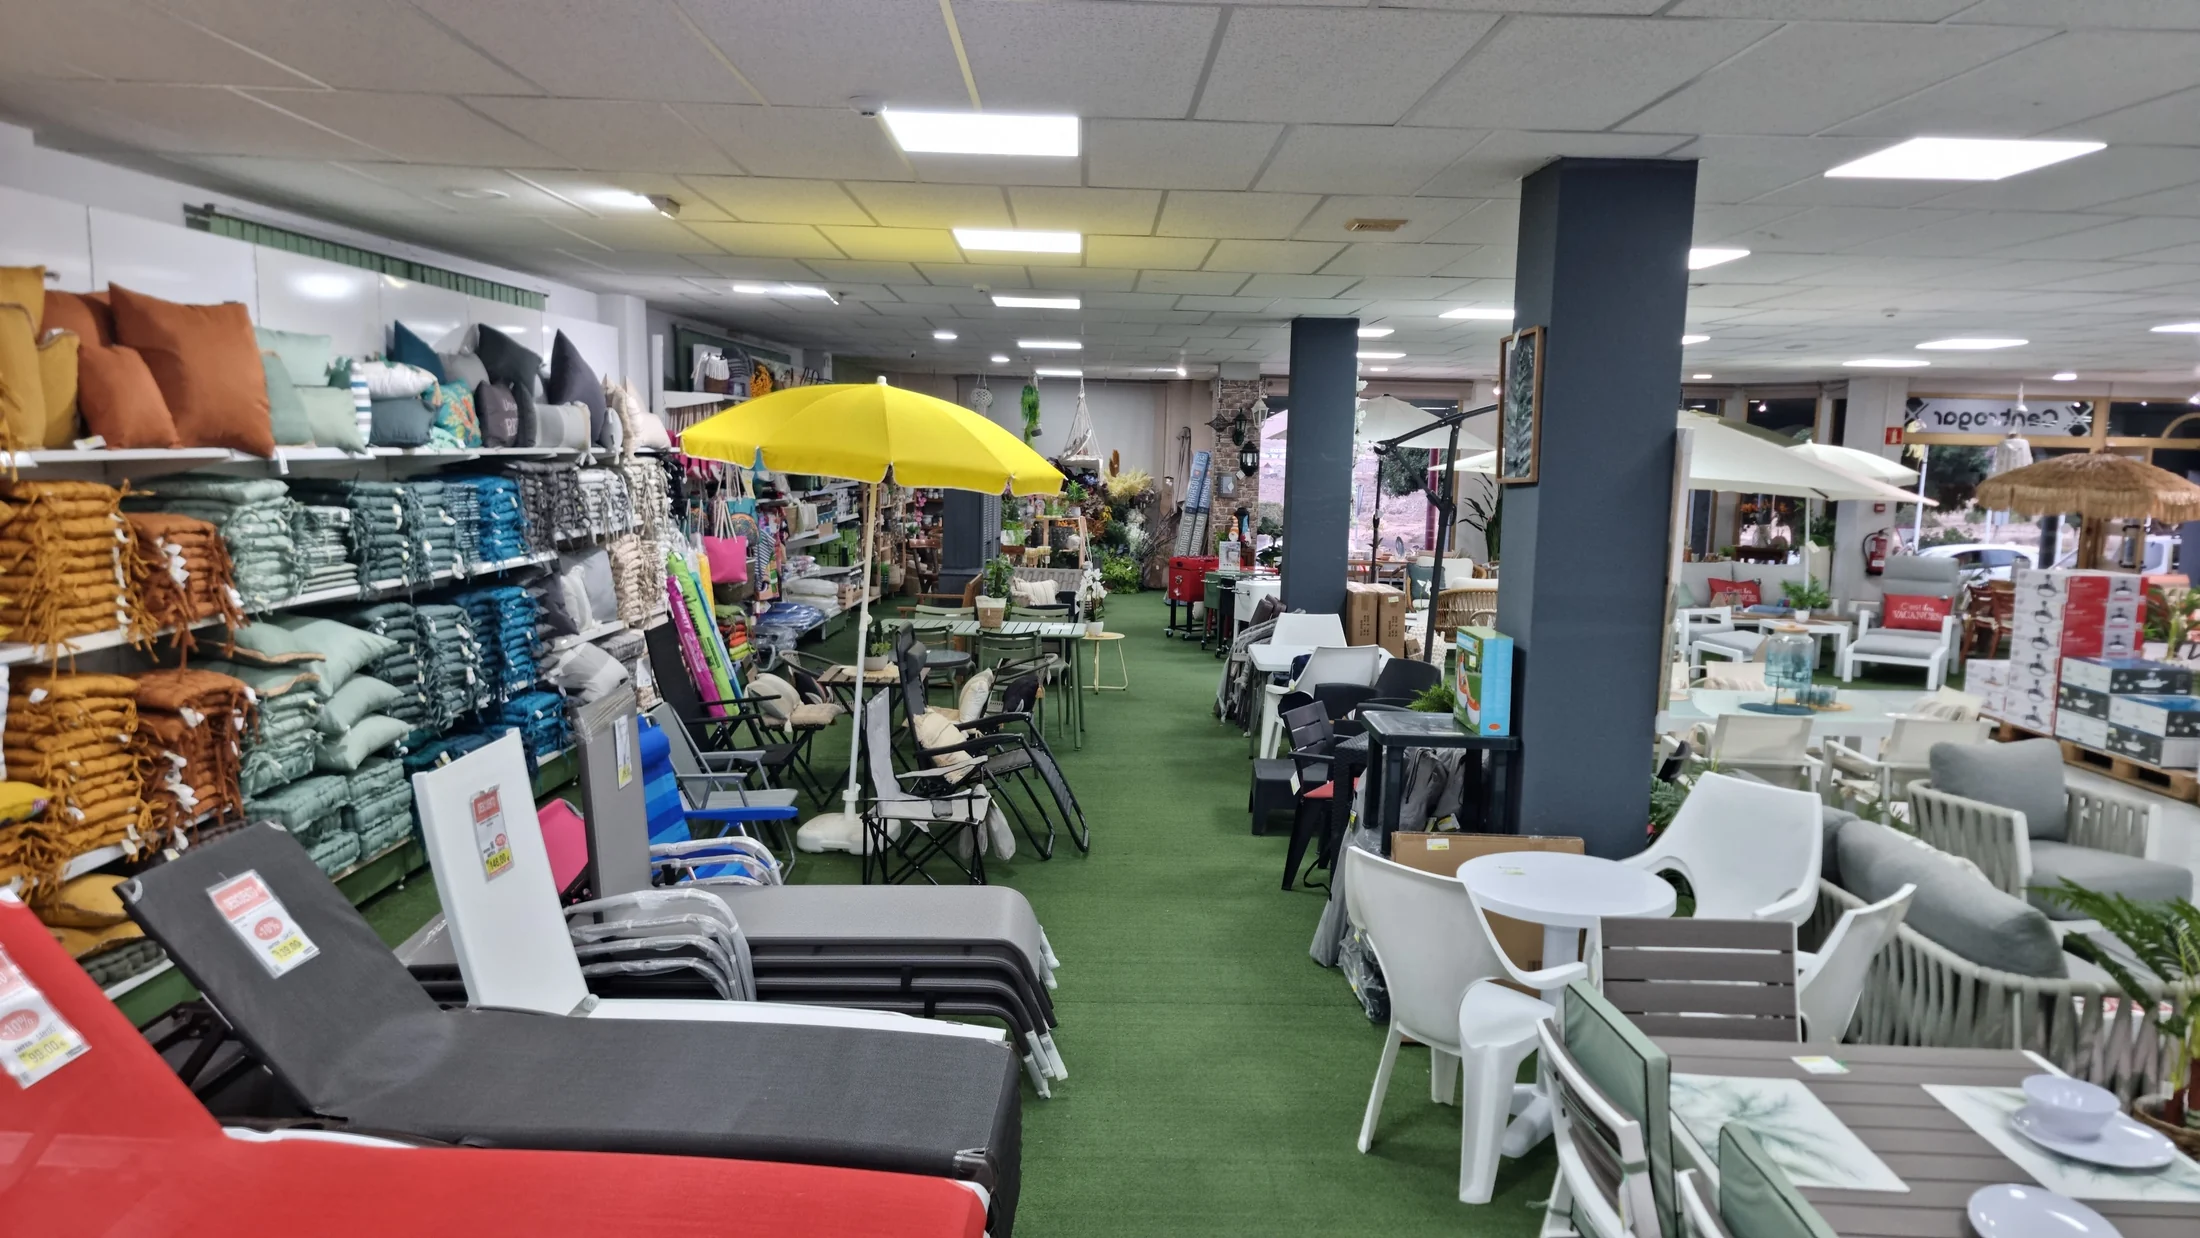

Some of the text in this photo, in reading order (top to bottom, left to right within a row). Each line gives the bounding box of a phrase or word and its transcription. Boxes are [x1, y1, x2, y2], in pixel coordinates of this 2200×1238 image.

[1179, 515, 1193, 556] SOMBRILLA
[1892, 609, 1943, 621] VACANCES
[2, 1013, 35, 1036] -10%
